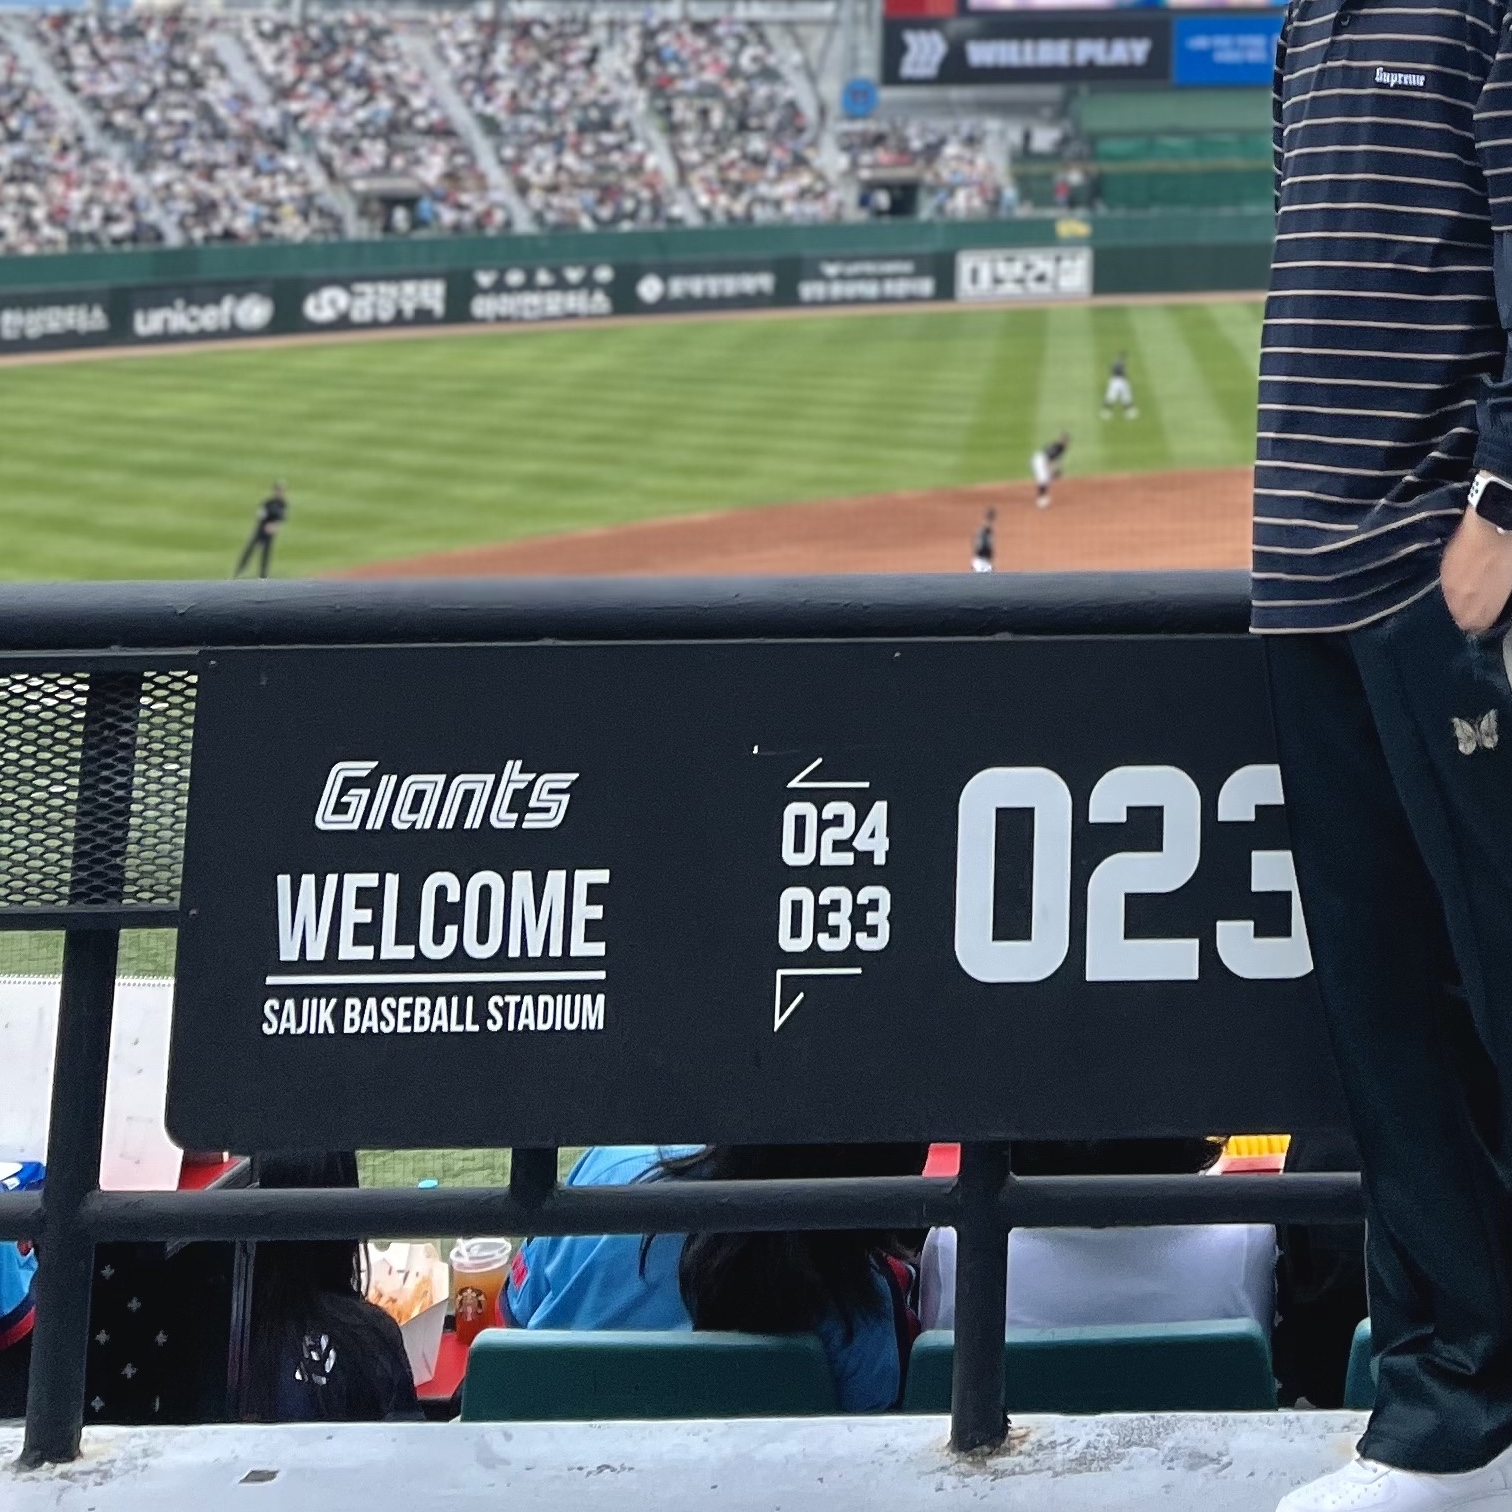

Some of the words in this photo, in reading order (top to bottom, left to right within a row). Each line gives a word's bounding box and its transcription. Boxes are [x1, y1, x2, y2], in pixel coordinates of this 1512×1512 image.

[1077, 37, 1152, 66] PLAY
[1375, 67, 1426, 87] Supreme
[134, 294, 238, 337] unicef
[350, 279, 446, 323] 금강주택
[315, 760, 579, 831] Giants
[782, 800, 890, 866] 024
[954, 764, 1314, 983] 023
[276, 868, 610, 962] WELCOME
[778, 885, 891, 952] 033
[262, 996, 335, 1035] SAJIK
[343, 994, 479, 1034] BASEBALL
[487, 993, 605, 1032] STADIUM
